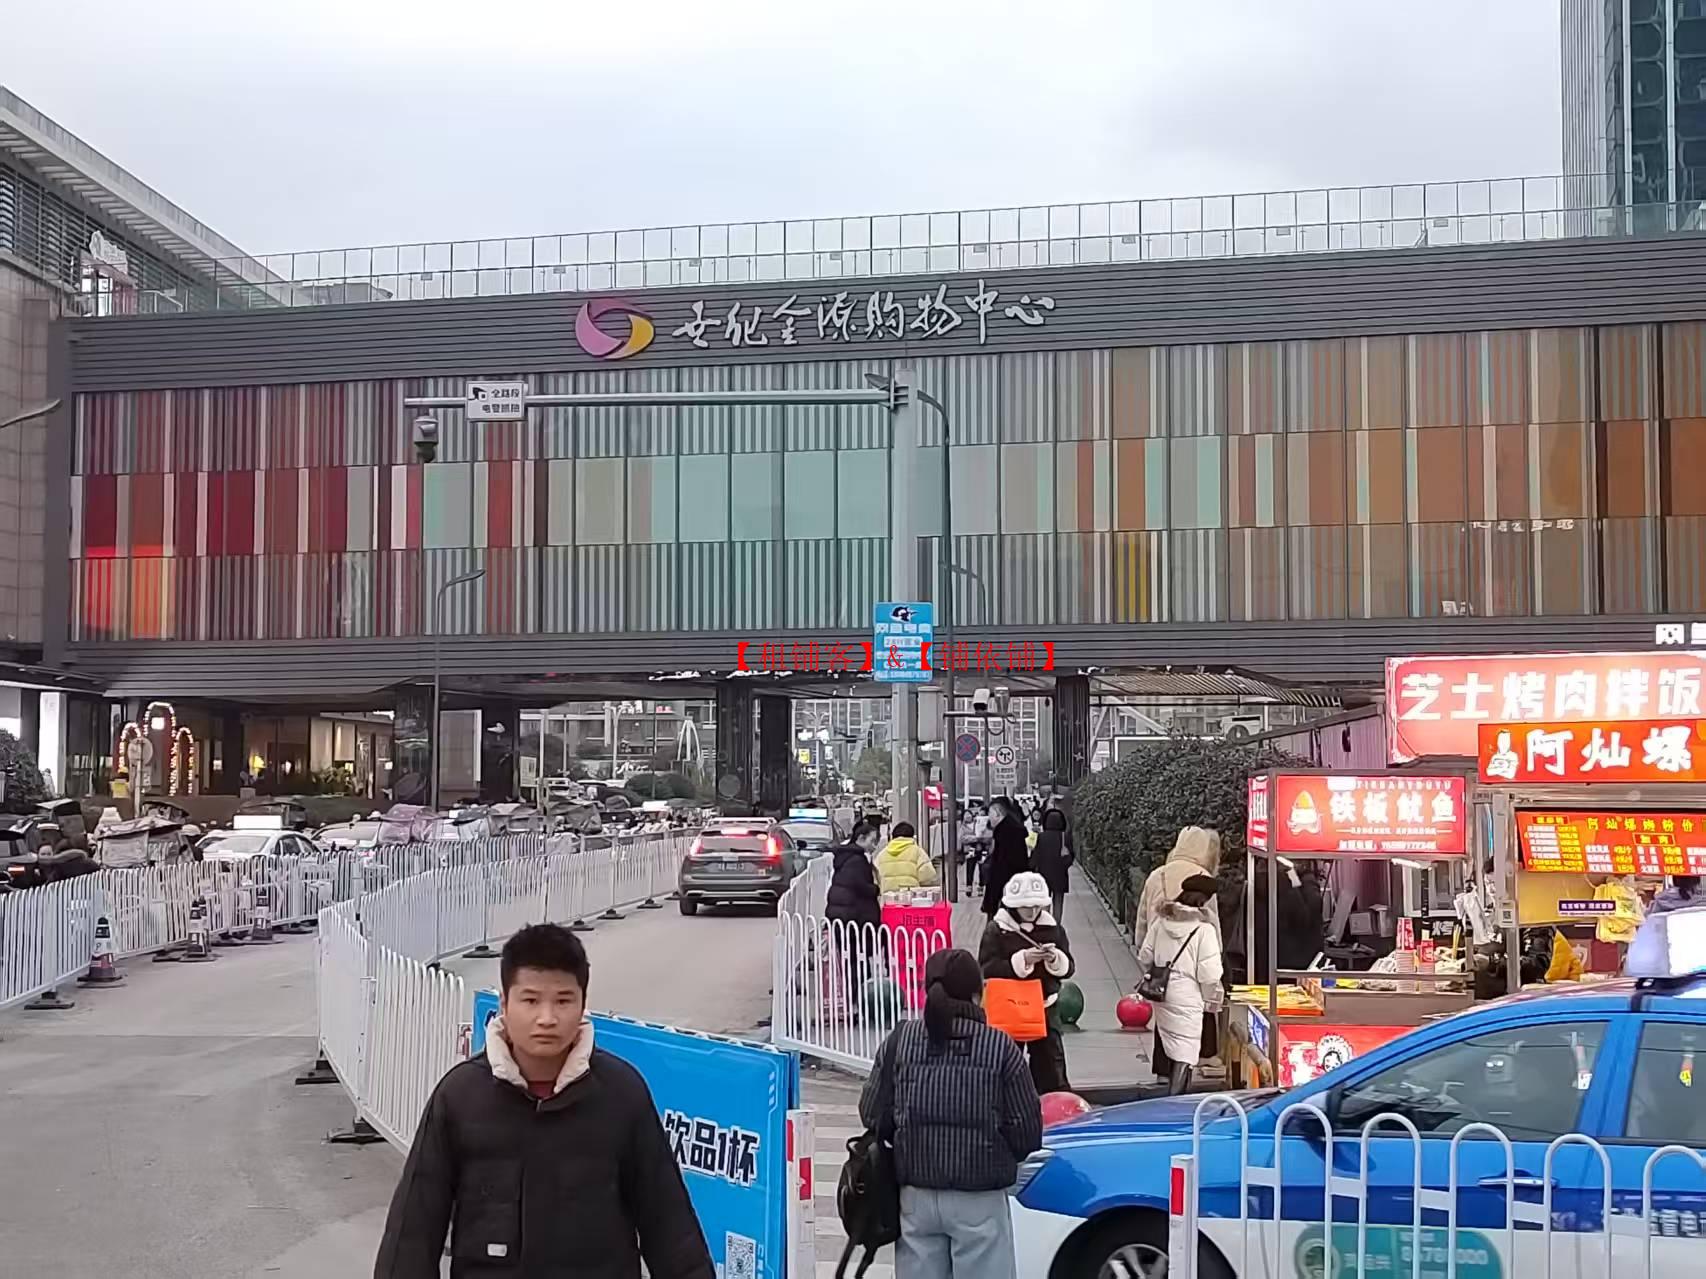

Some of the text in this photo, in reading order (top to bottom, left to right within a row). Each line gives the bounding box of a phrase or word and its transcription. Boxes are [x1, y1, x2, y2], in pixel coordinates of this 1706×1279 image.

[1400, 668, 1701, 721] 芝士烤肉拌饭
[1330, 790, 1457, 824] 铁板鱿鱼
